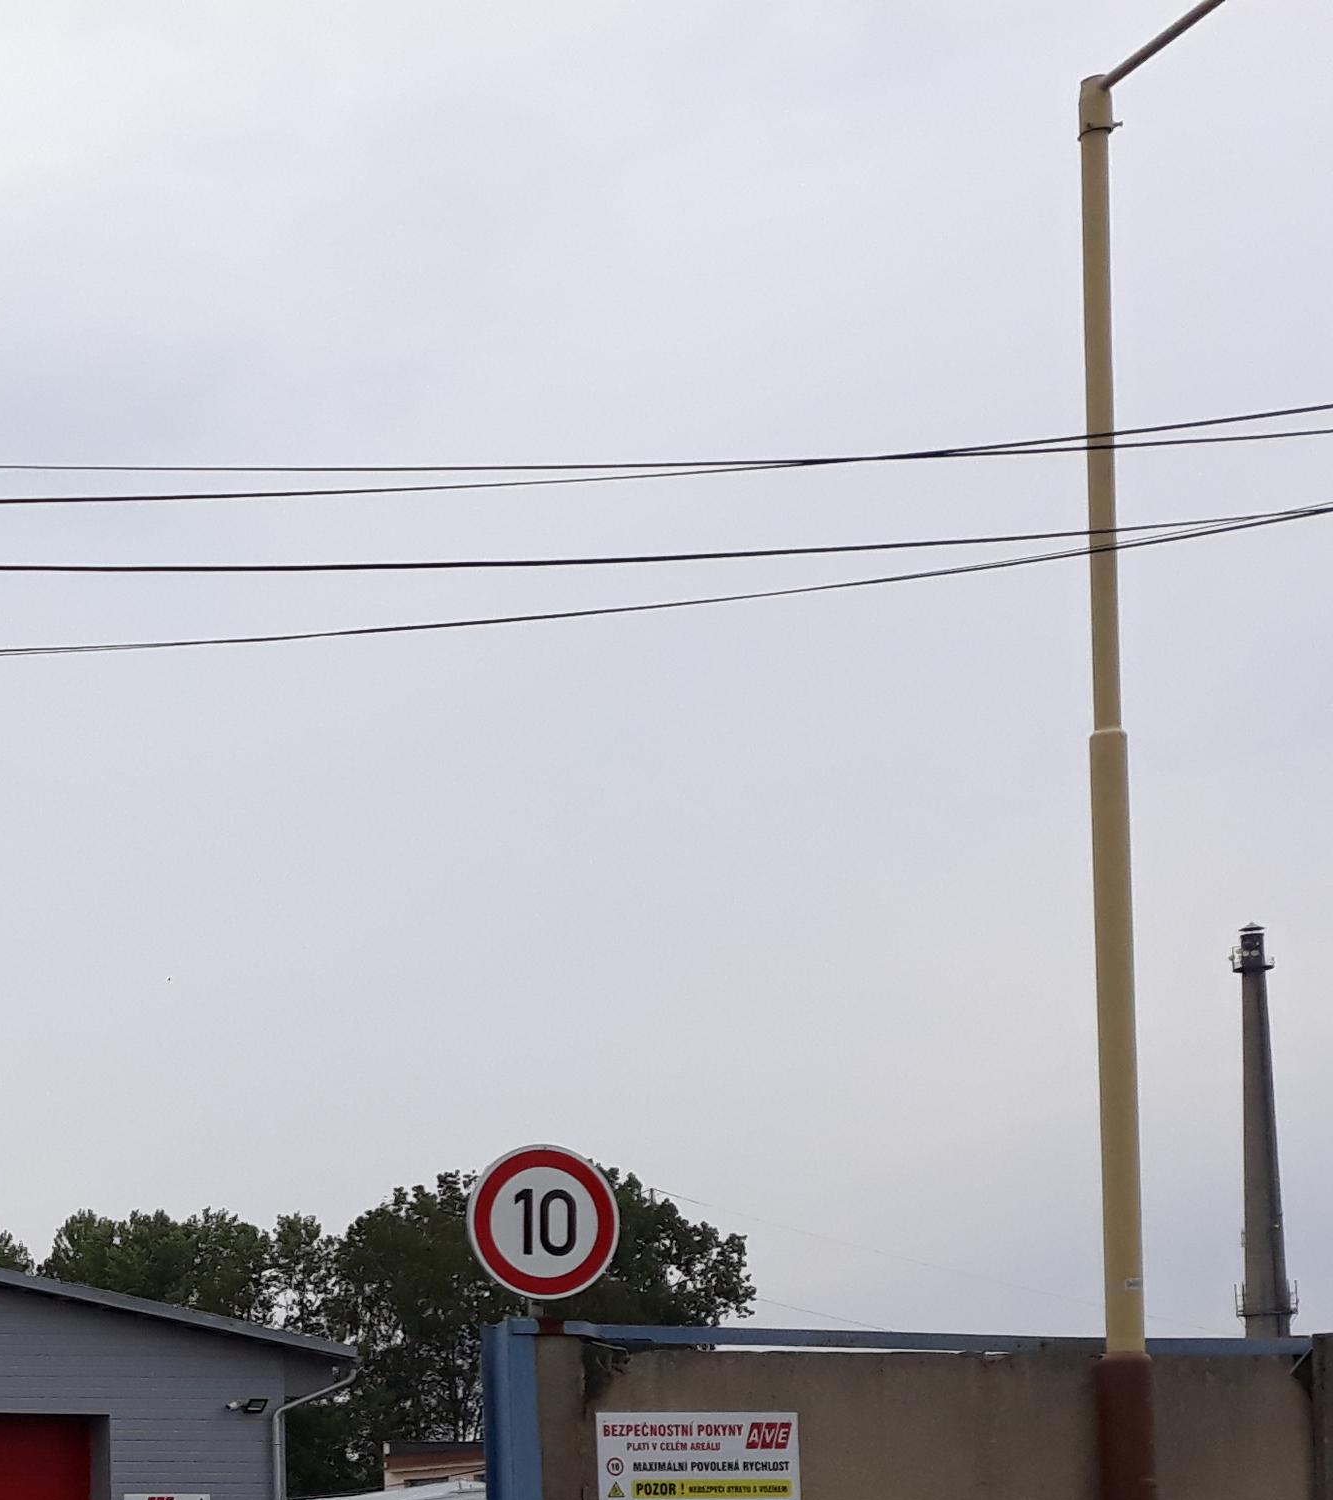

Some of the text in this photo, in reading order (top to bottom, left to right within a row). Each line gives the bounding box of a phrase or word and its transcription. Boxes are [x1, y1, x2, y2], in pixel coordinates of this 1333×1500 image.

[514, 1188, 577, 1256] 10
[602, 1421, 744, 1437] BEZPEČNOSTNÍ POKYNY
[747, 1427, 790, 1444] AVE
[651, 1442, 658, 1451] V
[636, 1482, 677, 1496] POZOR
